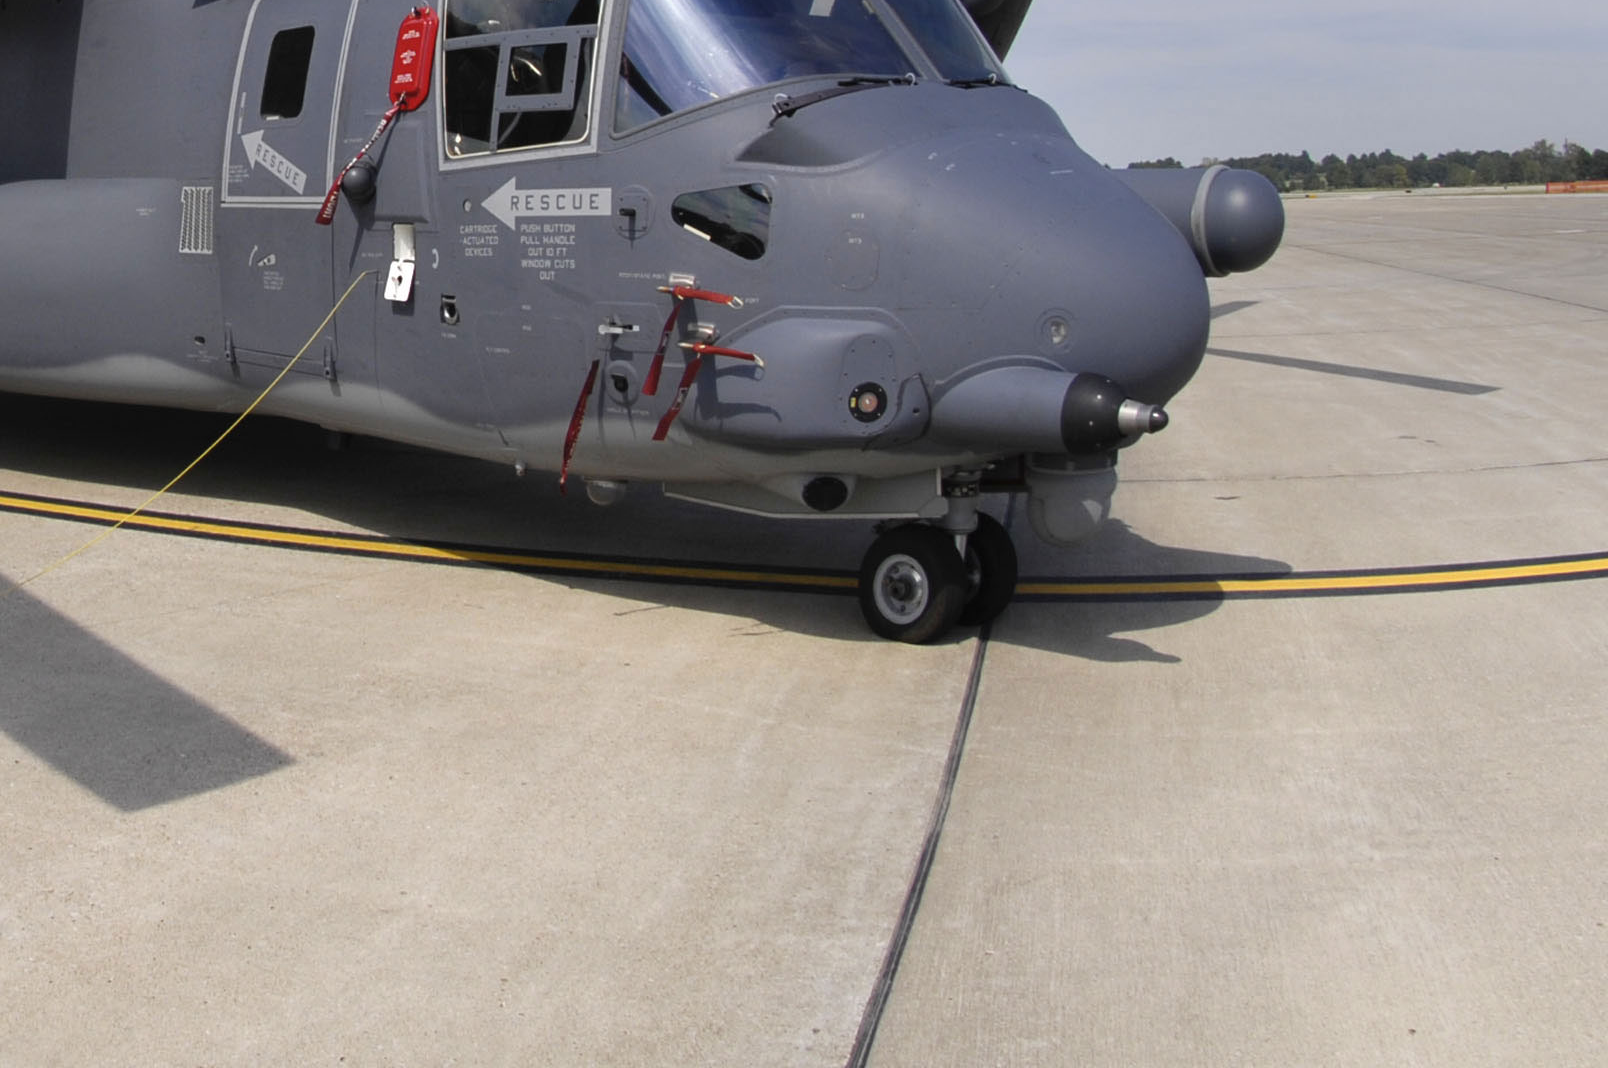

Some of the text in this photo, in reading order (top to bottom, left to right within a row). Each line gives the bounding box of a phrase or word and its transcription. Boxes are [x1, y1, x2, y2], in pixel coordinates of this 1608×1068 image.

[255, 142, 301, 187] RESCUE
[510, 193, 599, 211] RESCUE
[459, 224, 498, 234] CARTRIDGE
[520, 223, 576, 233] PUSH BUTTON
[520, 235, 576, 245] PULL HANDLE
[464, 247, 494, 257] DEVICES
[527, 247, 543, 257] OUT
[556, 247, 567, 257] FT
[521, 259, 576, 269] WINDOW CUTS
[539, 270, 555, 280] OUT
